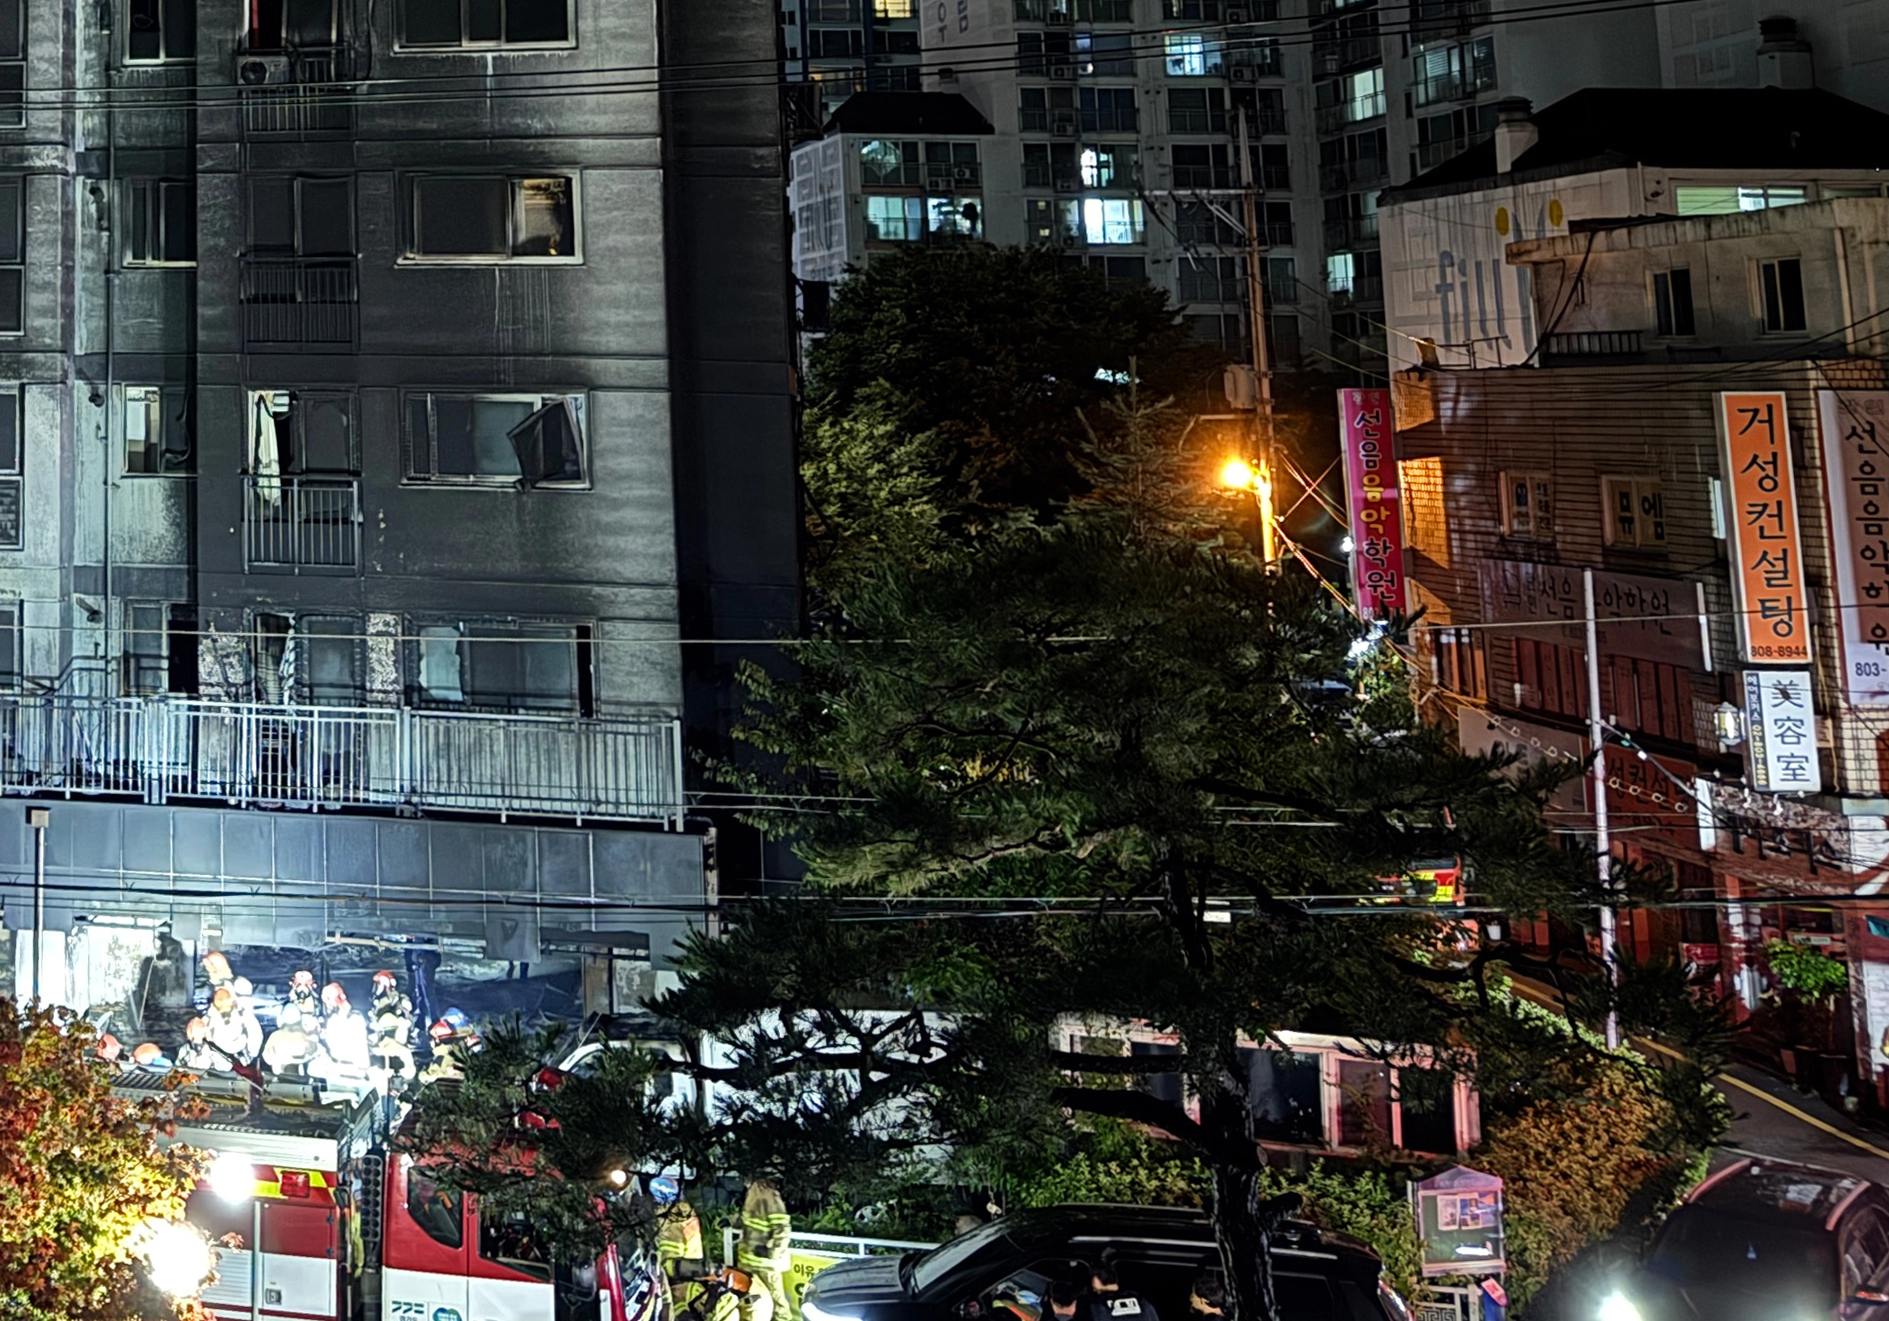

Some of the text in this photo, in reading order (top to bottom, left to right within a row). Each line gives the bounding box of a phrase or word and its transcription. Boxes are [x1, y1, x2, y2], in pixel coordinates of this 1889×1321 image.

[1354, 408, 1398, 602] 선음음악학원
[1737, 404, 1794, 638] 거성컨설팅
[1541, 575, 1673, 636] 선음악학원
[1750, 645, 1808, 658] 808-8944
[1771, 679, 1811, 782] 美容室
